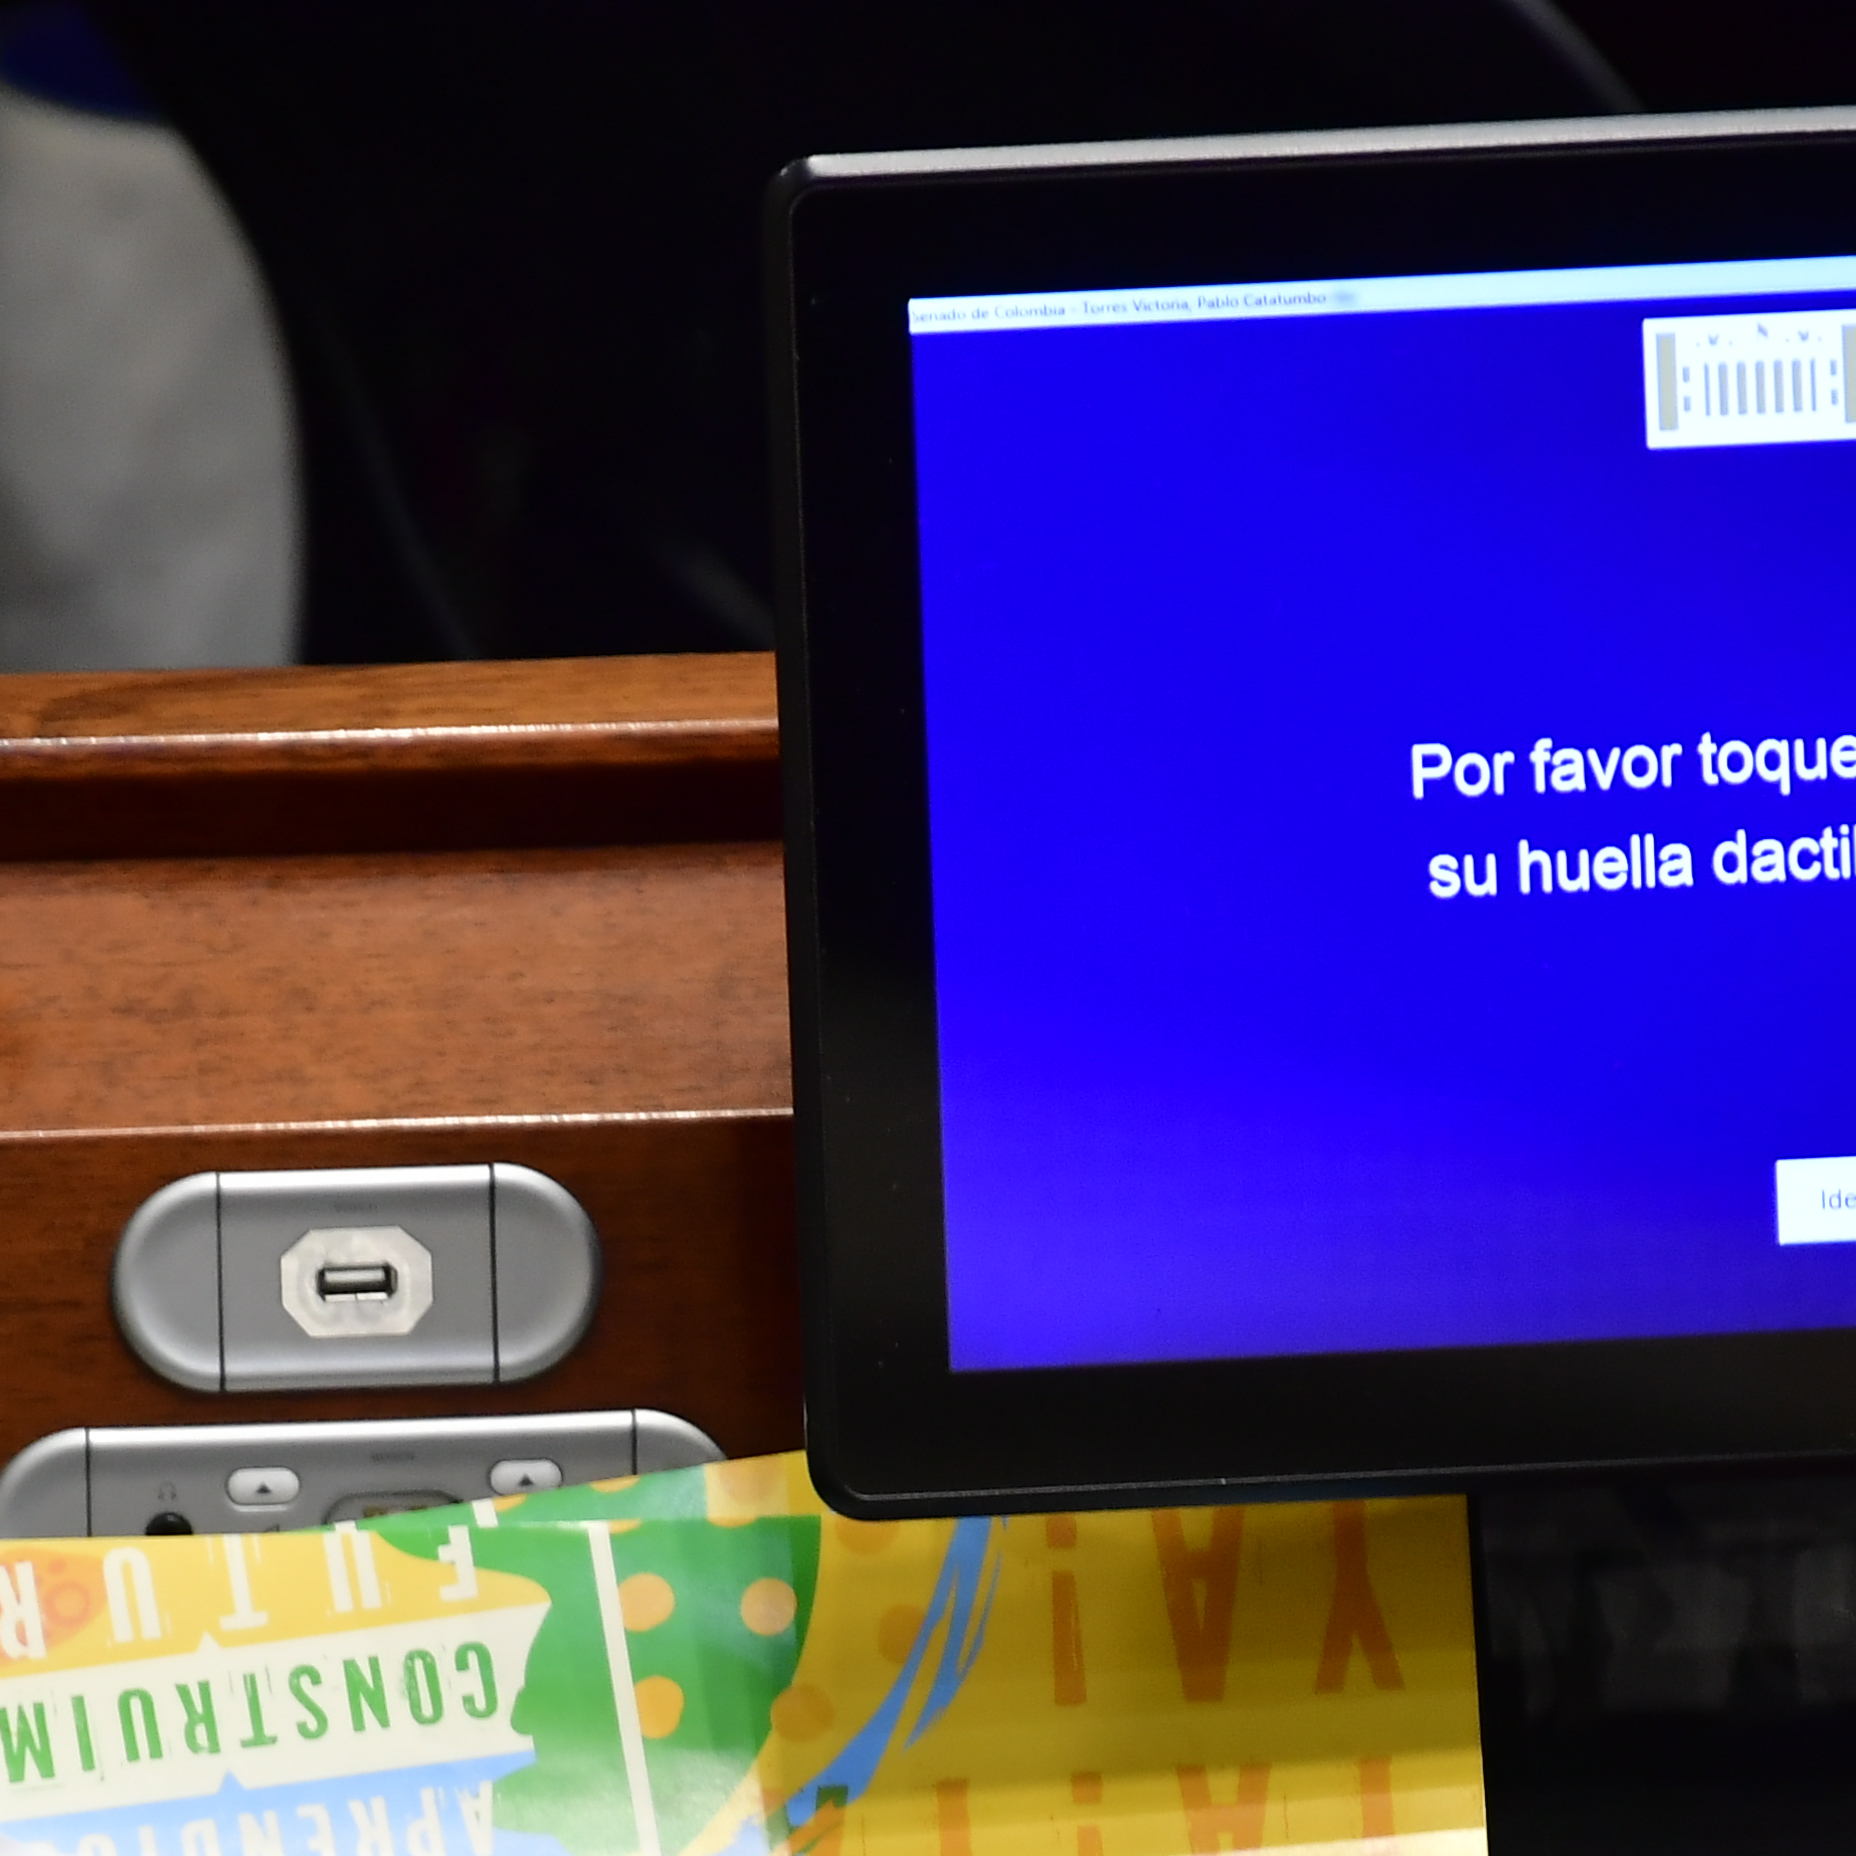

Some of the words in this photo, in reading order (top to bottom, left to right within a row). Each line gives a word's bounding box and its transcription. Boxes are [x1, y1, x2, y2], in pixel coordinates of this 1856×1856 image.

[972, 308, 990, 319] de
[995, 302, 1066, 319] Colombia
[1082, 301, 1128, 315] Torres
[1197, 294, 1240, 310] Pablo
[1243, 291, 1327, 308] Catatumbo
[1410, 740, 1515, 799] Por
[1529, 735, 1683, 796] favor
[1427, 846, 1499, 900] su
[1518, 833, 1696, 895] huella
